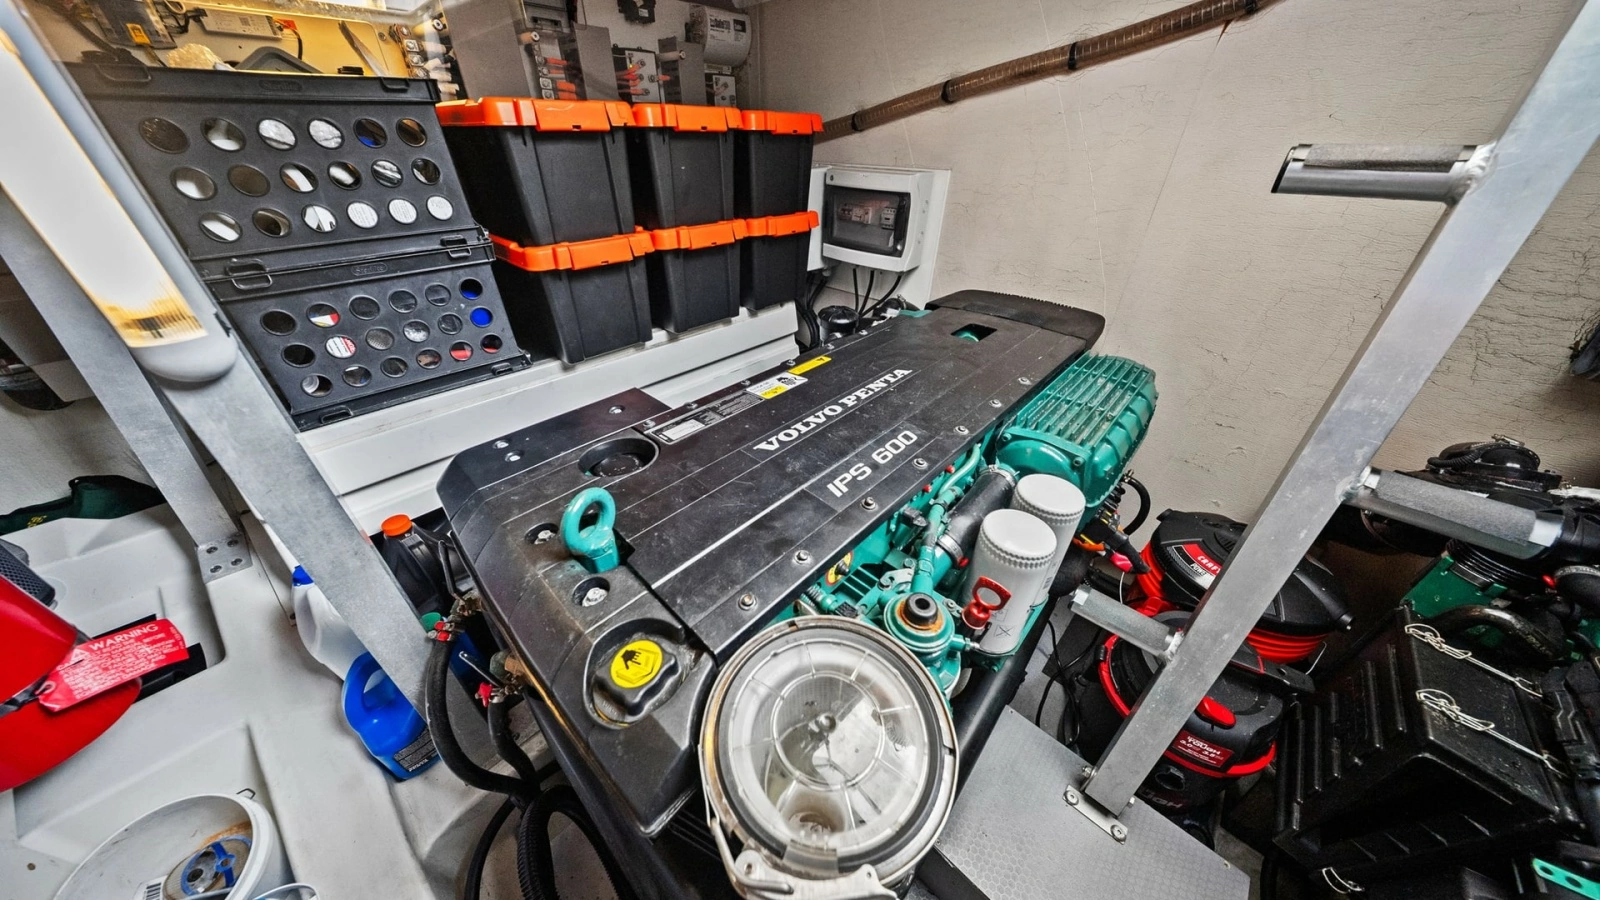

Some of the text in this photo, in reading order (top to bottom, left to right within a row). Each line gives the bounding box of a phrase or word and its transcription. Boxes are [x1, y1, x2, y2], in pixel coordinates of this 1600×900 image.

[753, 405, 843, 451] VOLVO
[838, 368, 913, 407] PENTA
[826, 430, 918, 498] IPS 600
[88, 624, 159, 651] WARNING
